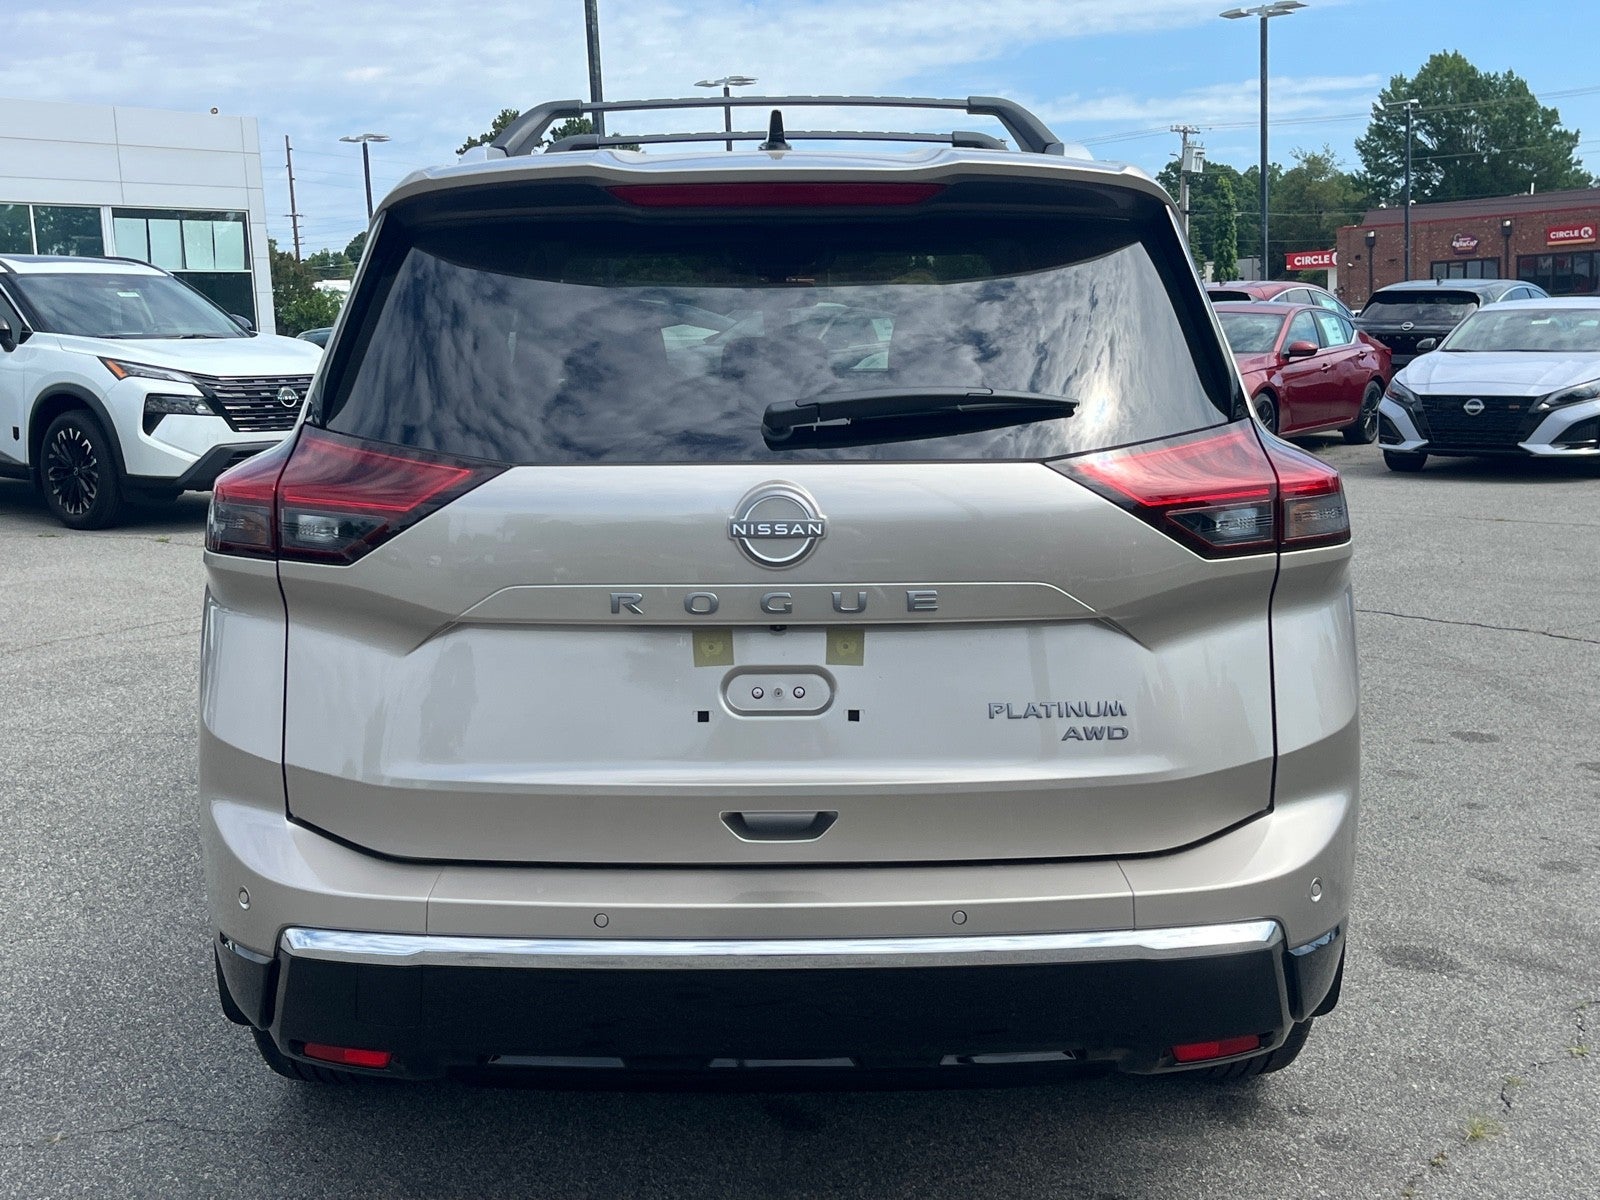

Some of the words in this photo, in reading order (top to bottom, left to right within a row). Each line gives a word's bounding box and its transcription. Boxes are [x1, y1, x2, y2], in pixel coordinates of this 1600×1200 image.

[1550, 230, 1579, 239] CIRCLE
[1581, 227, 1592, 238] K
[1294, 254, 1330, 266] CIRCLE
[732, 523, 822, 535] NISSAN
[610, 590, 938, 615] ROGUE
[988, 700, 1127, 720] PLATINUM
[1061, 725, 1129, 742] AWD
